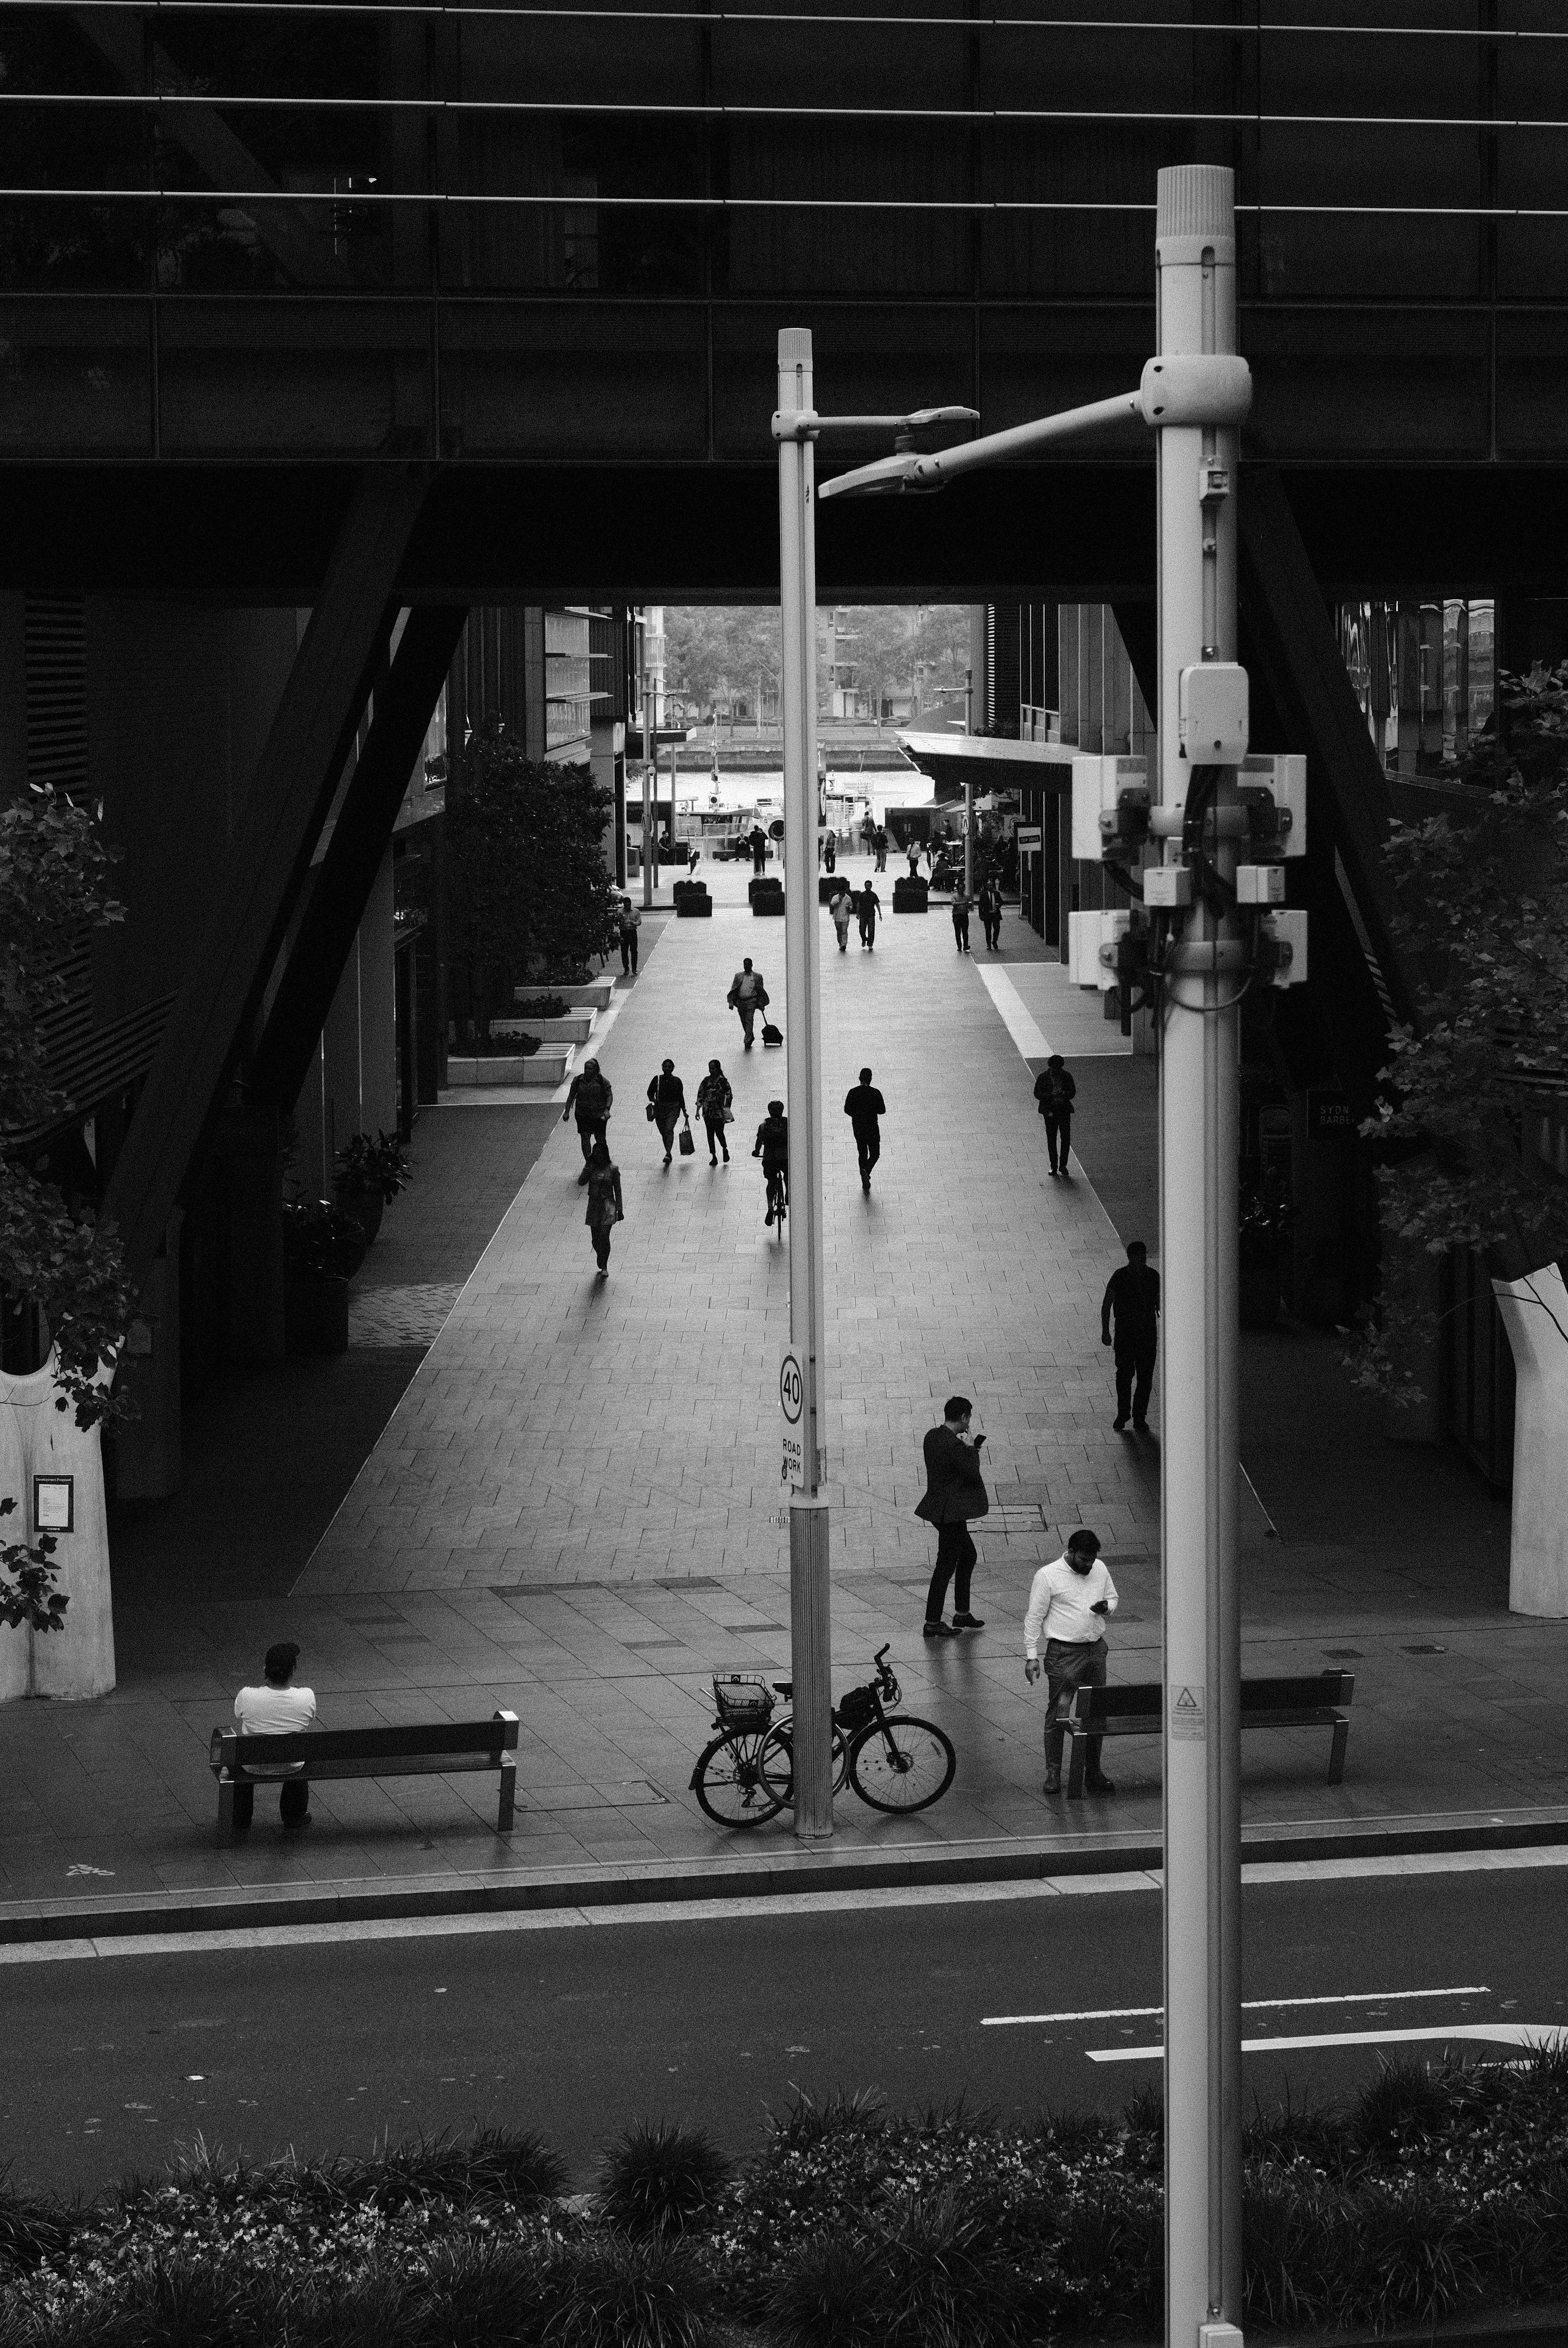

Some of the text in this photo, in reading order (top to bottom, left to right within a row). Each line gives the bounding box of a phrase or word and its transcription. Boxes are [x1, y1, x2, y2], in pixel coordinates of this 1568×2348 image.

[1320, 1105, 1349, 1114] SYDN
[1320, 1115, 1354, 1125] BARBE
[783, 1371, 800, 1404] 40
[783, 1438, 801, 1456] ROAD
[783, 1455, 801, 1473] WORK
